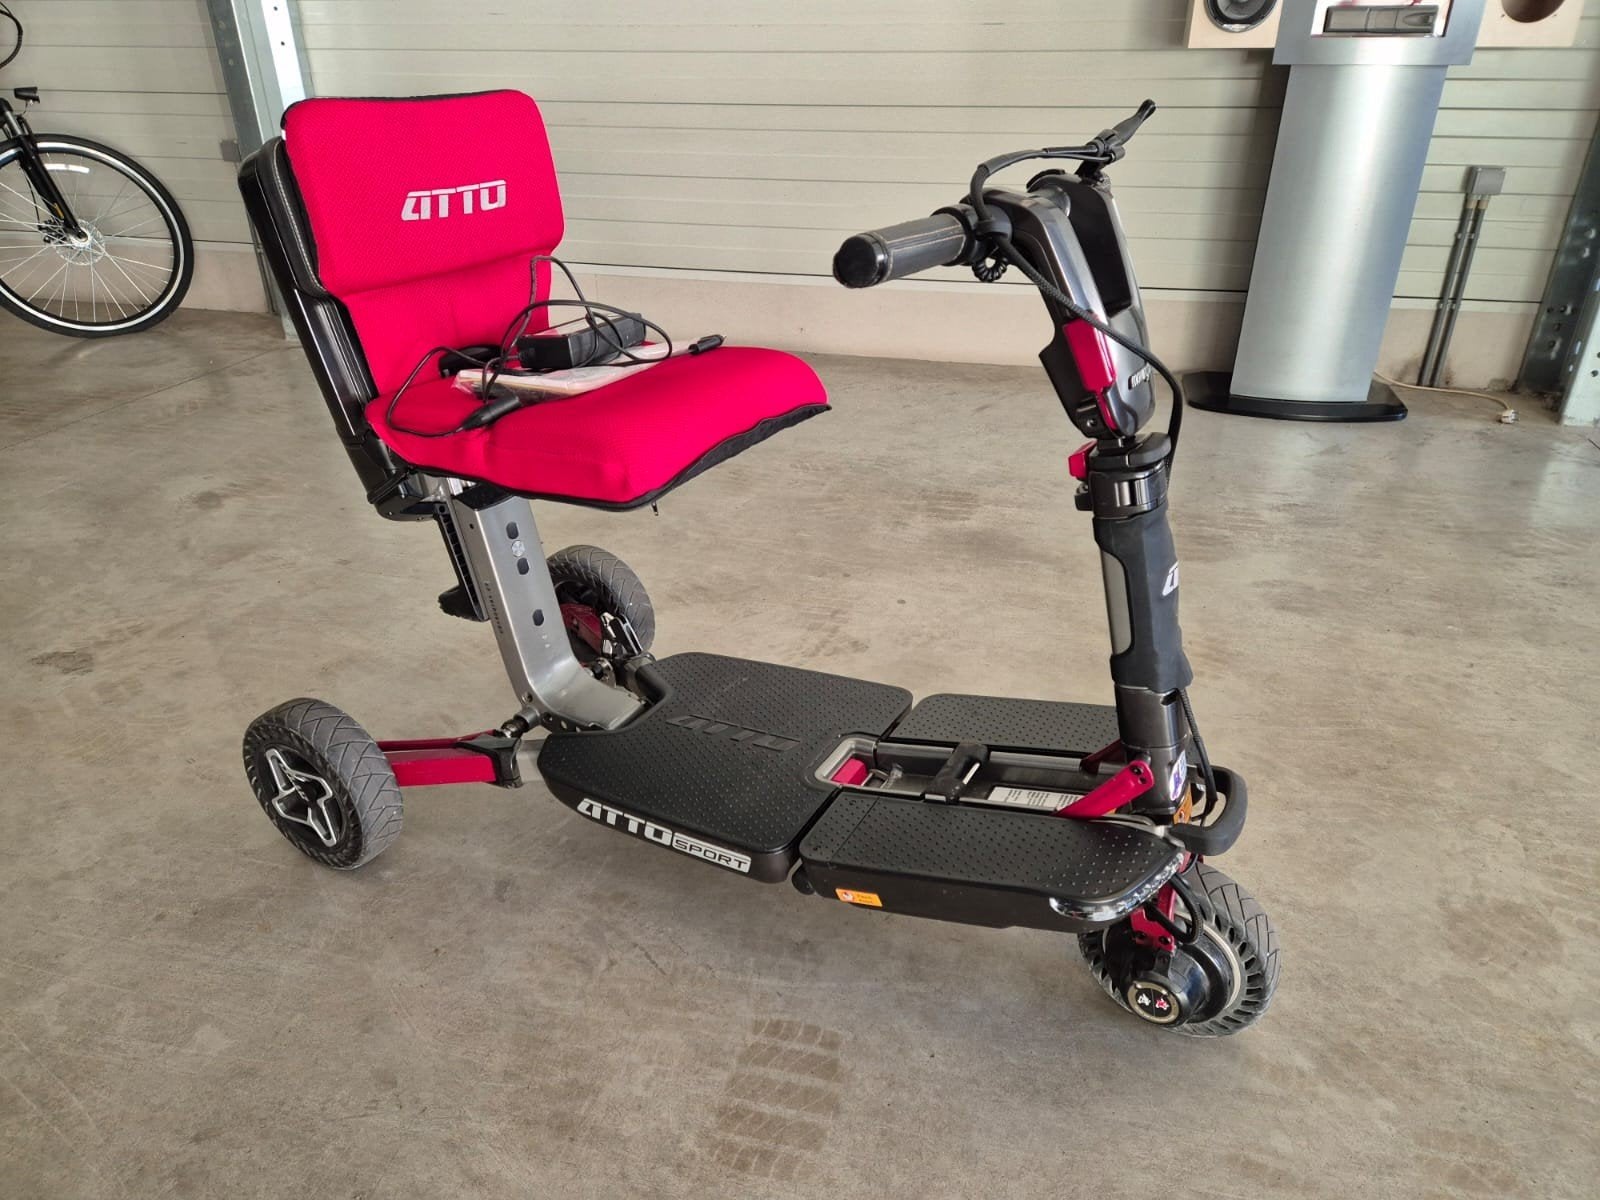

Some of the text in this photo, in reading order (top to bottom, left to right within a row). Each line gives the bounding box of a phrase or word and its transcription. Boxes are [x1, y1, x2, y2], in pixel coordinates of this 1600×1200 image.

[401, 179, 507, 221] ATTO
[576, 798, 749, 870] ATTO SPORT
